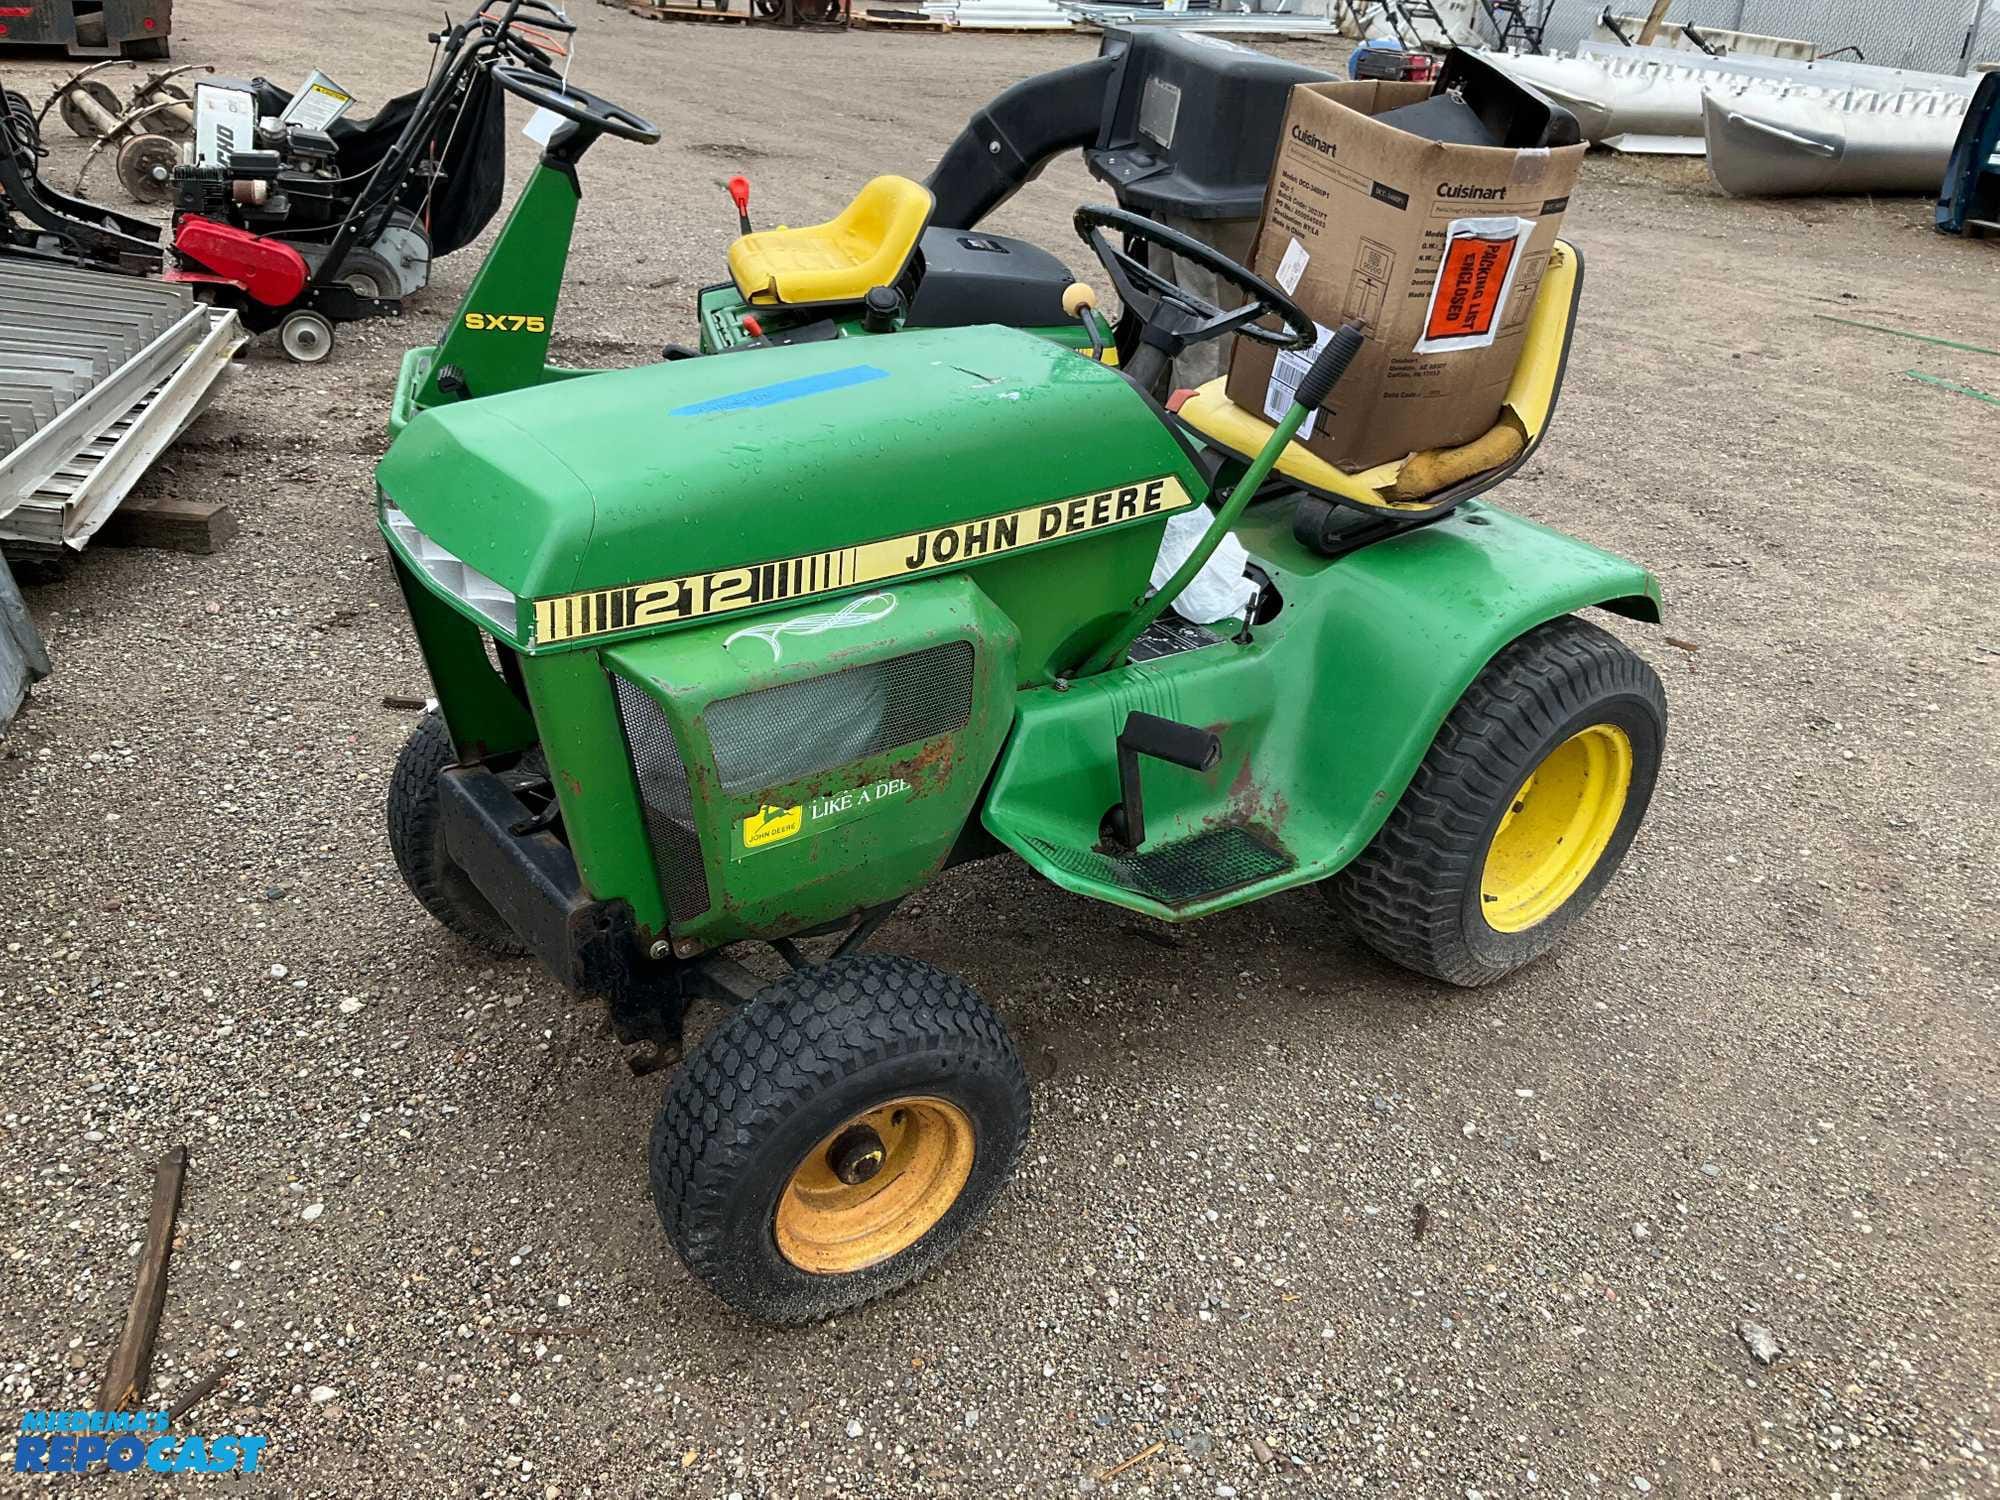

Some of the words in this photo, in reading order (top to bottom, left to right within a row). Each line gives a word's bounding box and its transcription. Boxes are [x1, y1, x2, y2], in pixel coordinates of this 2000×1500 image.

[1292, 124, 1337, 158] Cuisinart
[1437, 182, 1506, 200] Cuisinart
[1446, 252, 1475, 321] ENCLOSED
[1472, 244, 1501, 300] PACKING
[464, 312, 546, 334] SX75
[1462, 303, 1481, 330] LIST
[905, 515, 1020, 570] JOHN
[1038, 480, 1165, 540] DEERE
[634, 568, 753, 625] 212
[811, 794, 853, 820] LIKE
[857, 789, 871, 805] A
[749, 831, 770, 843] JOHN
[770, 822, 796, 836] DEERE
